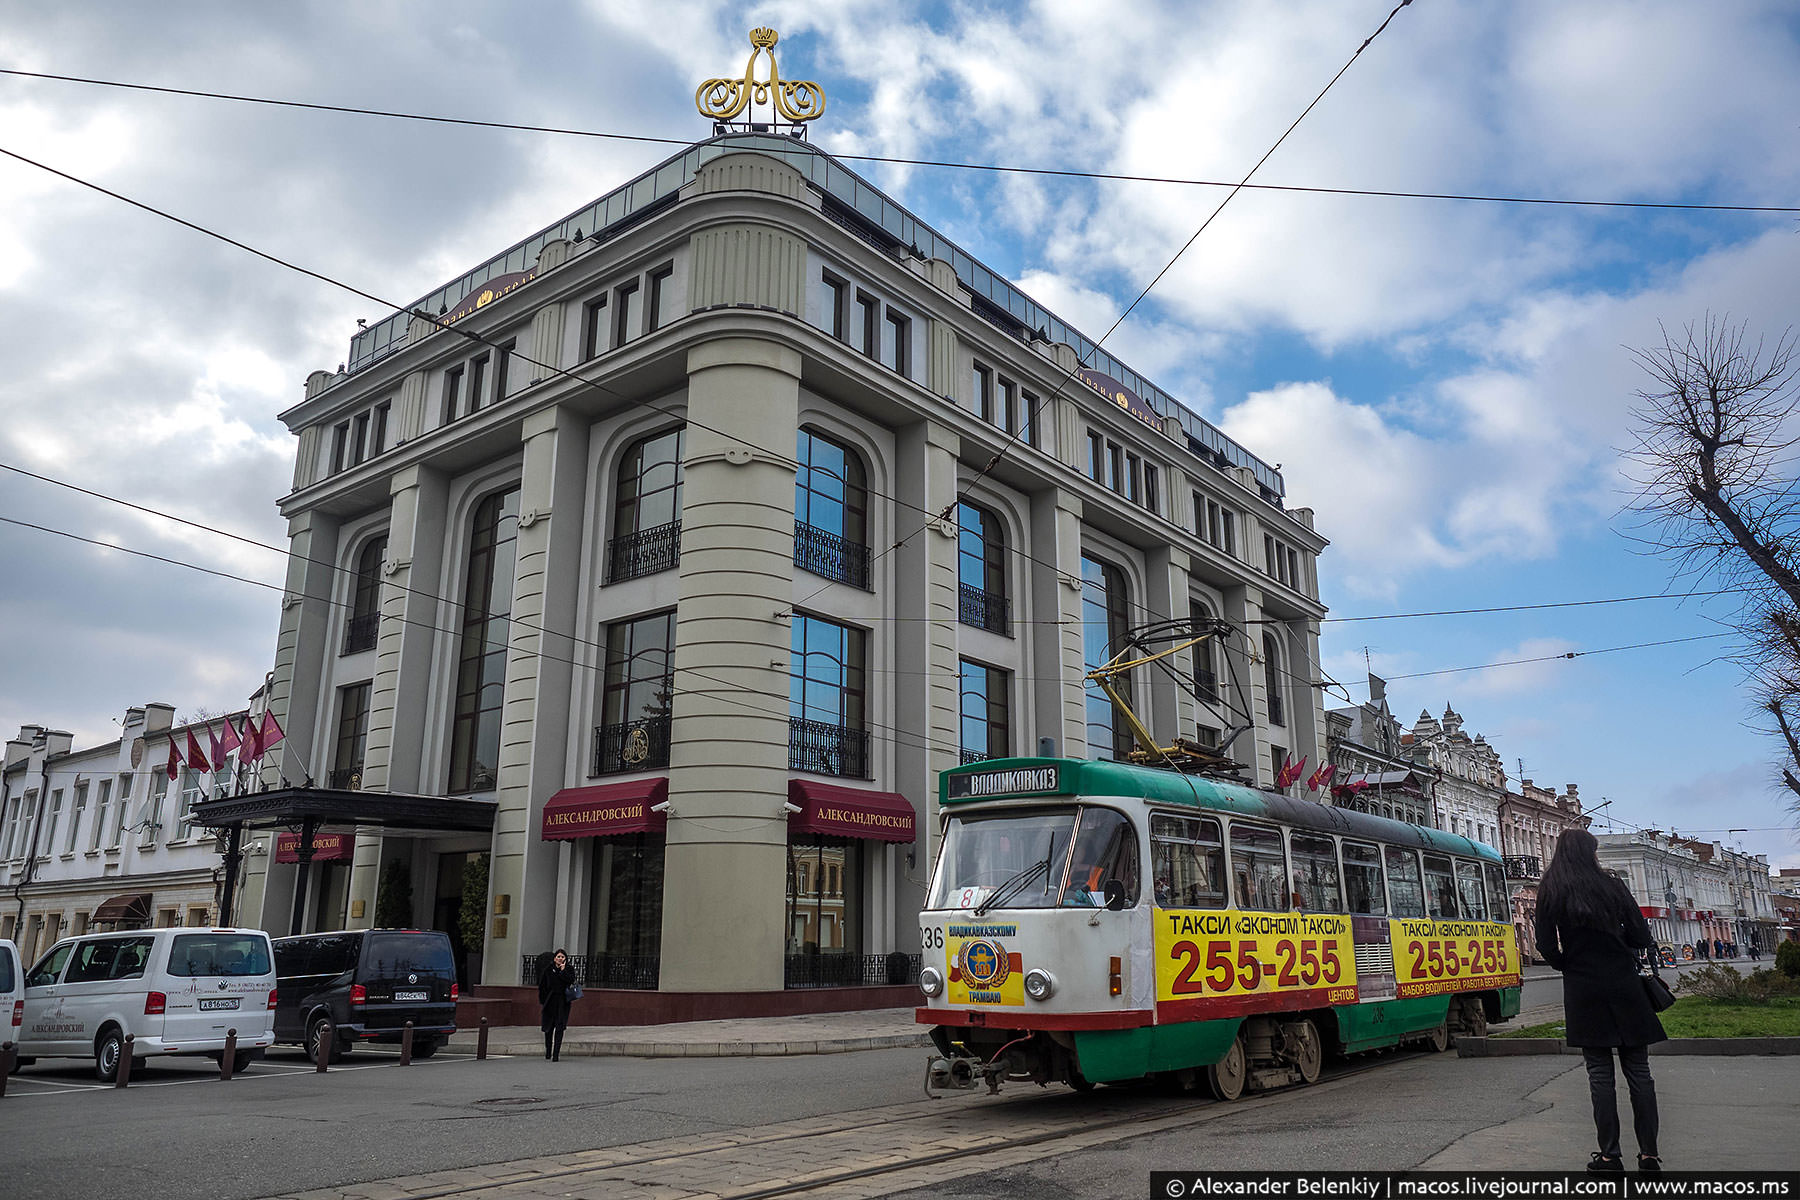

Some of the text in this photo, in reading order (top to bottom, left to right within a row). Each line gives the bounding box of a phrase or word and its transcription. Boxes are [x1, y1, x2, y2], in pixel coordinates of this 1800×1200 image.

[971, 768, 1056, 795] ВЛАДИКАВКАЗ
[546, 803, 643, 826] АЛЕКСАНДРОВСКИЙ
[817, 807, 913, 829] АЛЕКСАНДРОВСКИЙ
[960, 888, 974, 909] 8
[948, 925, 1016, 938] ВЛАДИКАВКАЗСКОМУ
[1169, 915, 1346, 935] ТАКСИ «ЭКОНОМ ТАКСИ»
[1401, 923, 1506, 937] ТАКСИ «ЭКОНОМ ТАКСИ»
[1170, 939, 1342, 995] 255-255
[1408, 940, 1507, 979] 255-255
[968, 991, 1001, 1003] ТРАМВАЮ
[1328, 988, 1355, 1002] ЦЕНТОВ
[1401, 984, 1424, 996] НАБОР
[1463, 978, 1484, 990] РАБОТА
